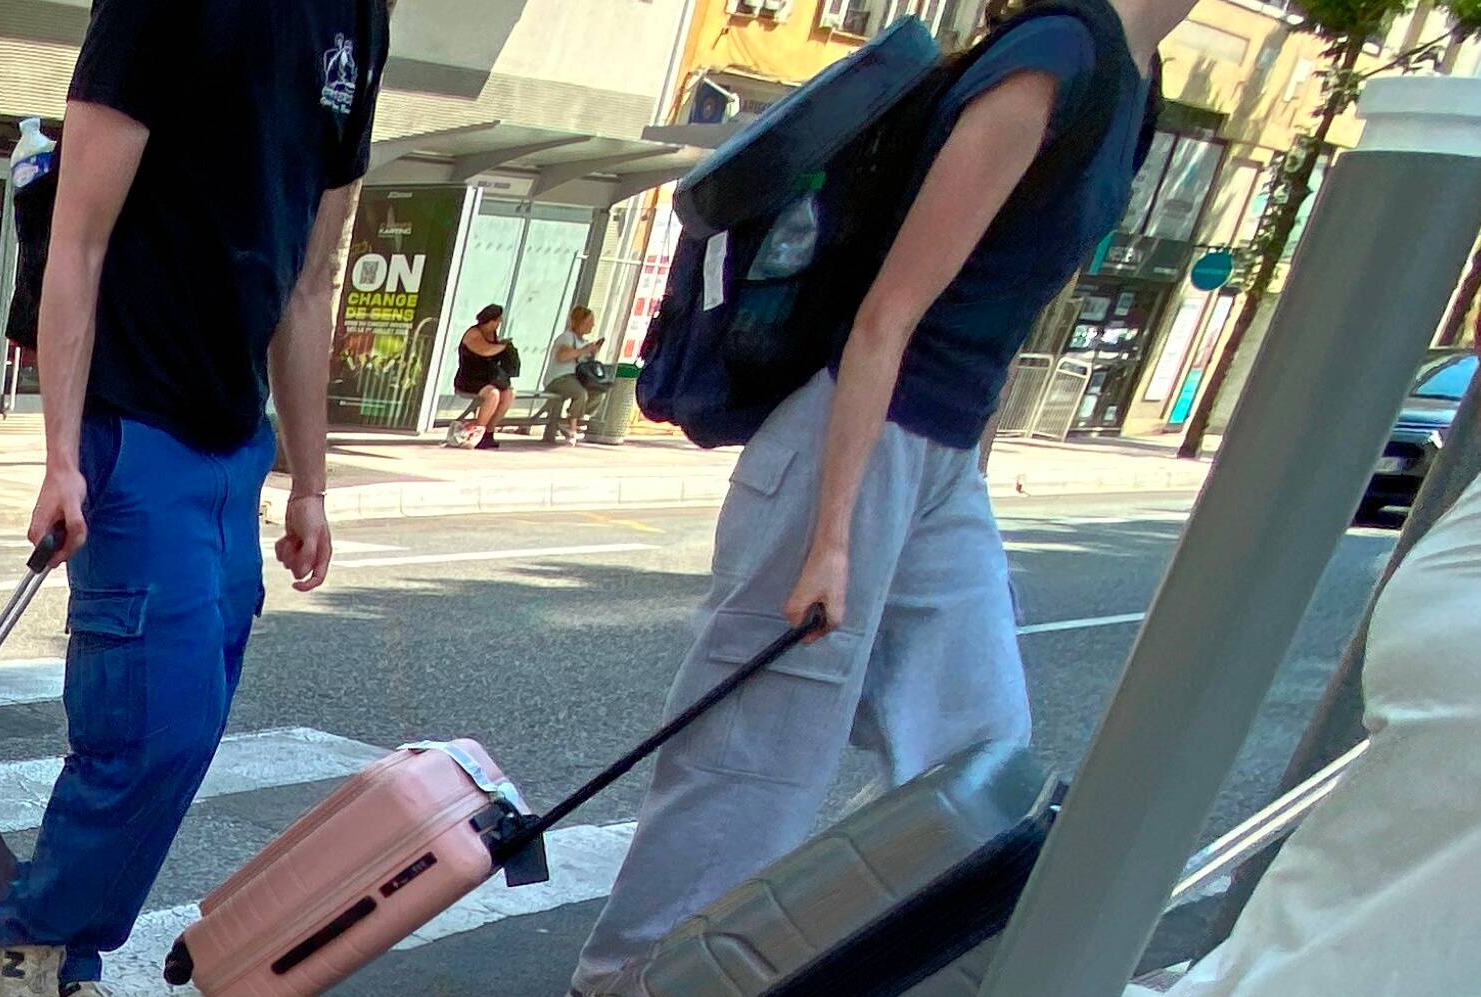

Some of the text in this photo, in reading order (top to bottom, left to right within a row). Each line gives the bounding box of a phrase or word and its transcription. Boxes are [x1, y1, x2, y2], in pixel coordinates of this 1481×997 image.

[352, 253, 427, 293] ON
[347, 292, 419, 308] CHANGE
[344, 306, 416, 322] DE SENS
